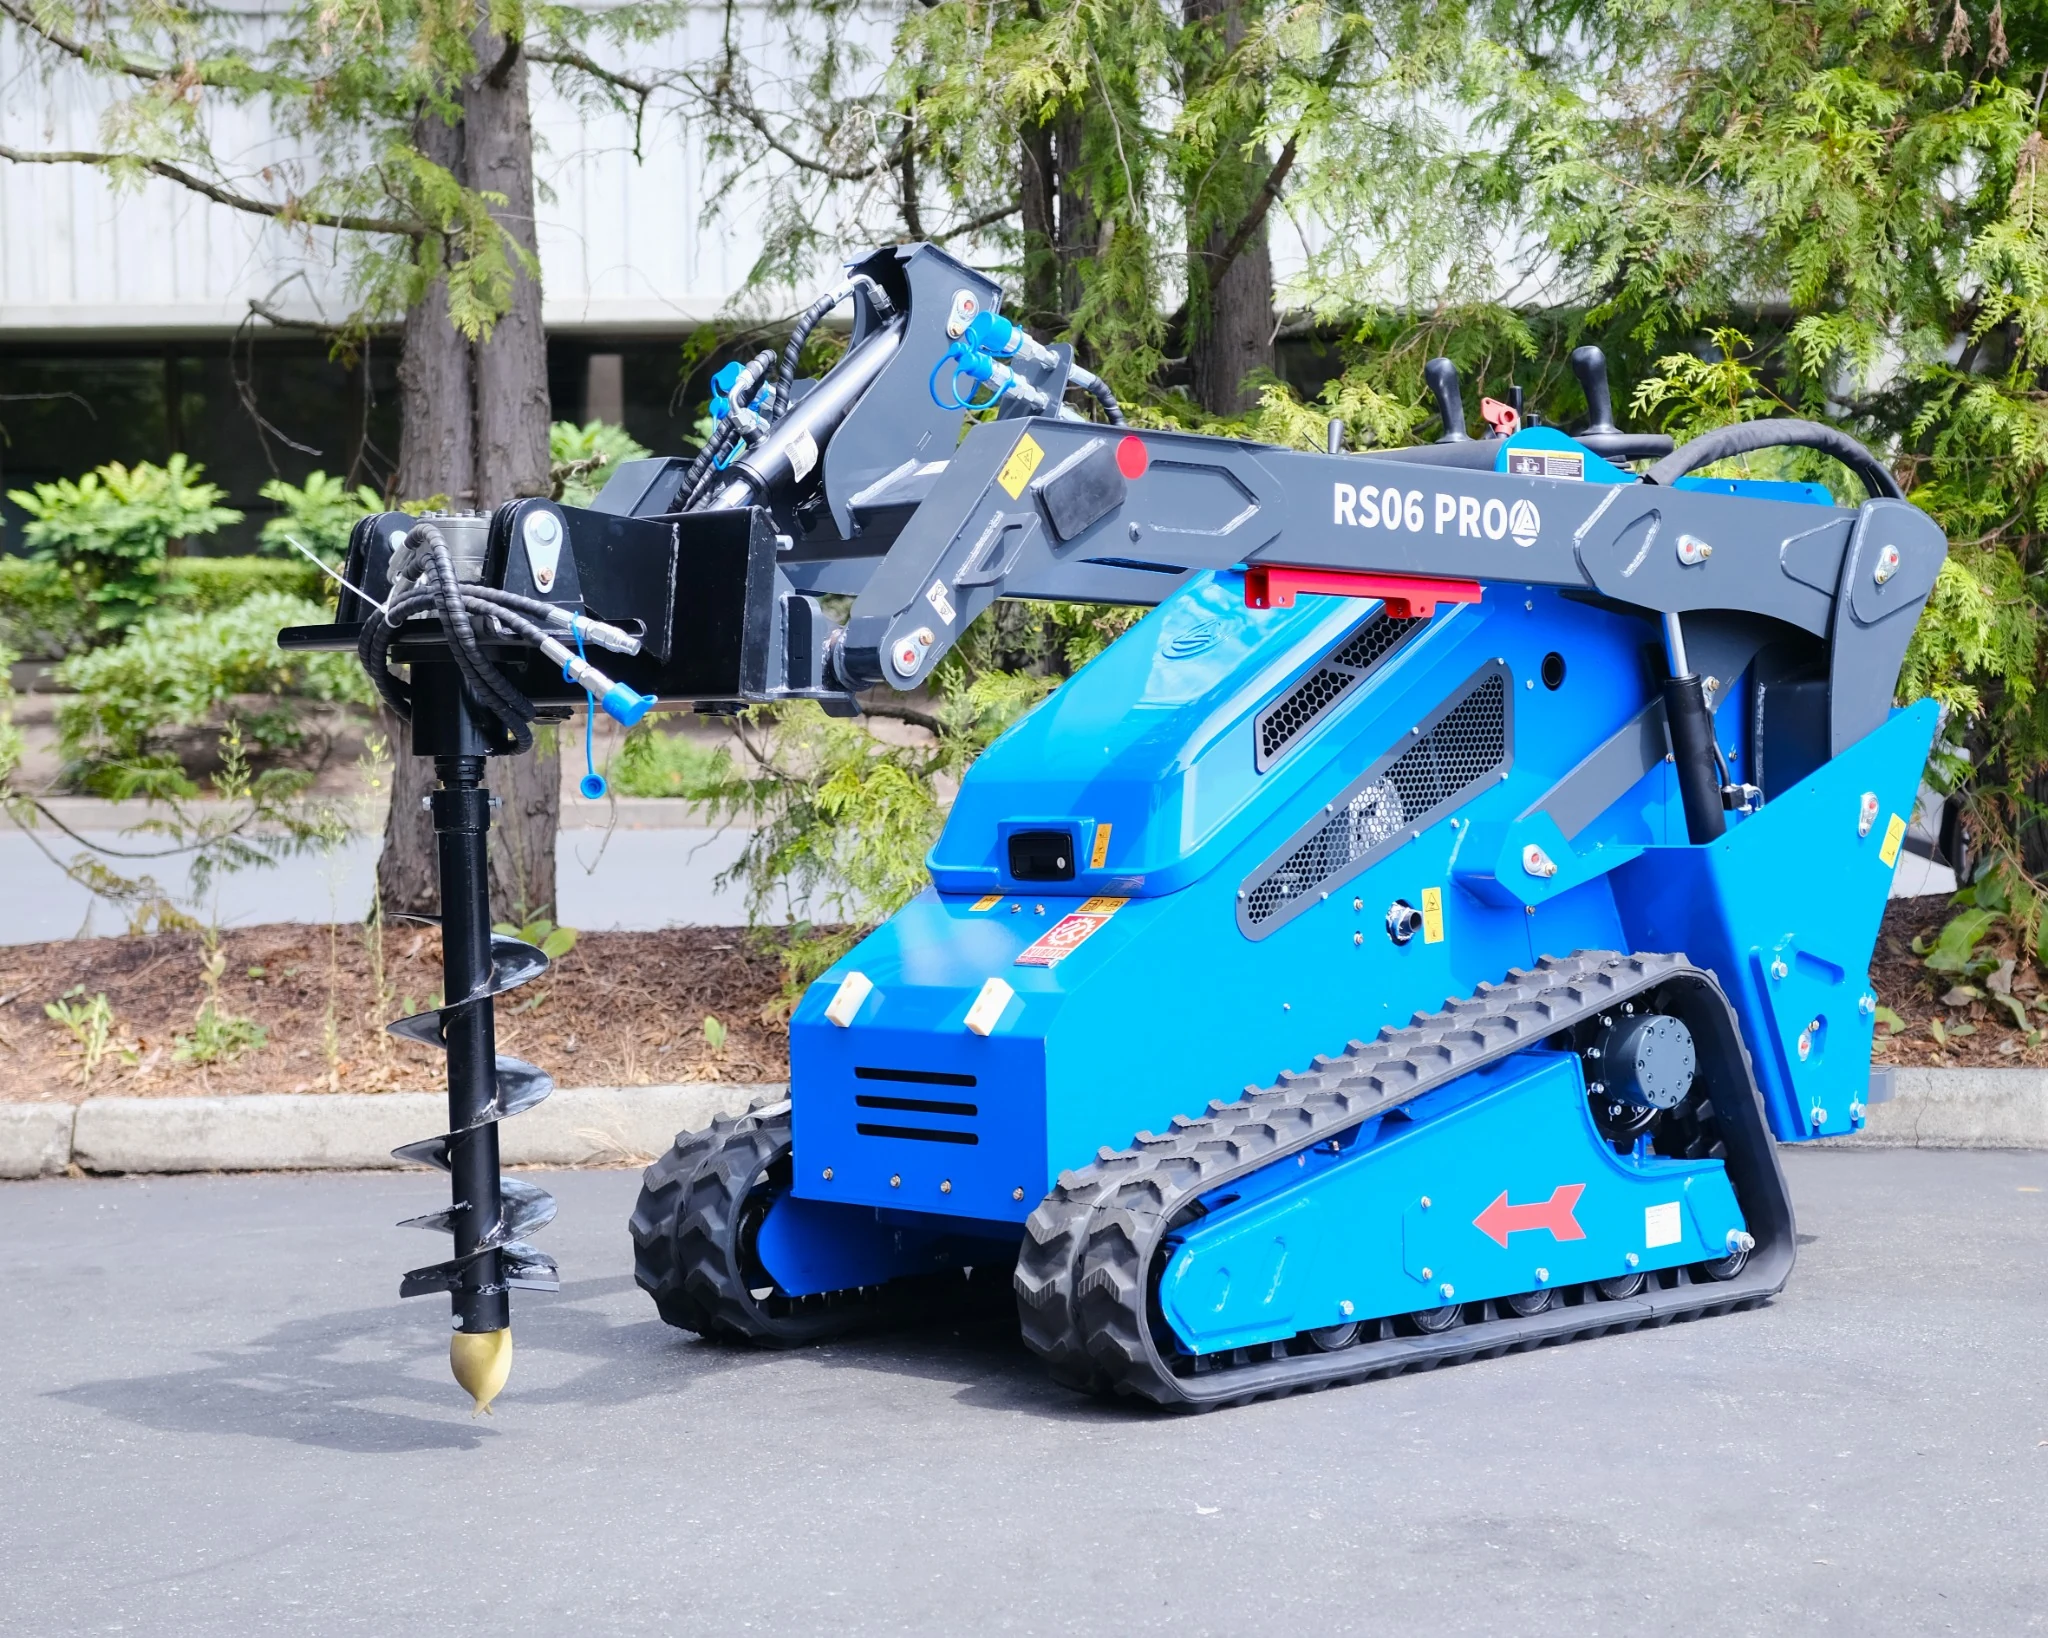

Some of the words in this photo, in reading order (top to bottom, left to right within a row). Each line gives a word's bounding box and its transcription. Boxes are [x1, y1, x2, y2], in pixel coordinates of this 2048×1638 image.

[1334, 482, 1424, 532] RS06
[1434, 493, 1508, 540] PRO
[1023, 948, 1071, 958] KUBOTA
